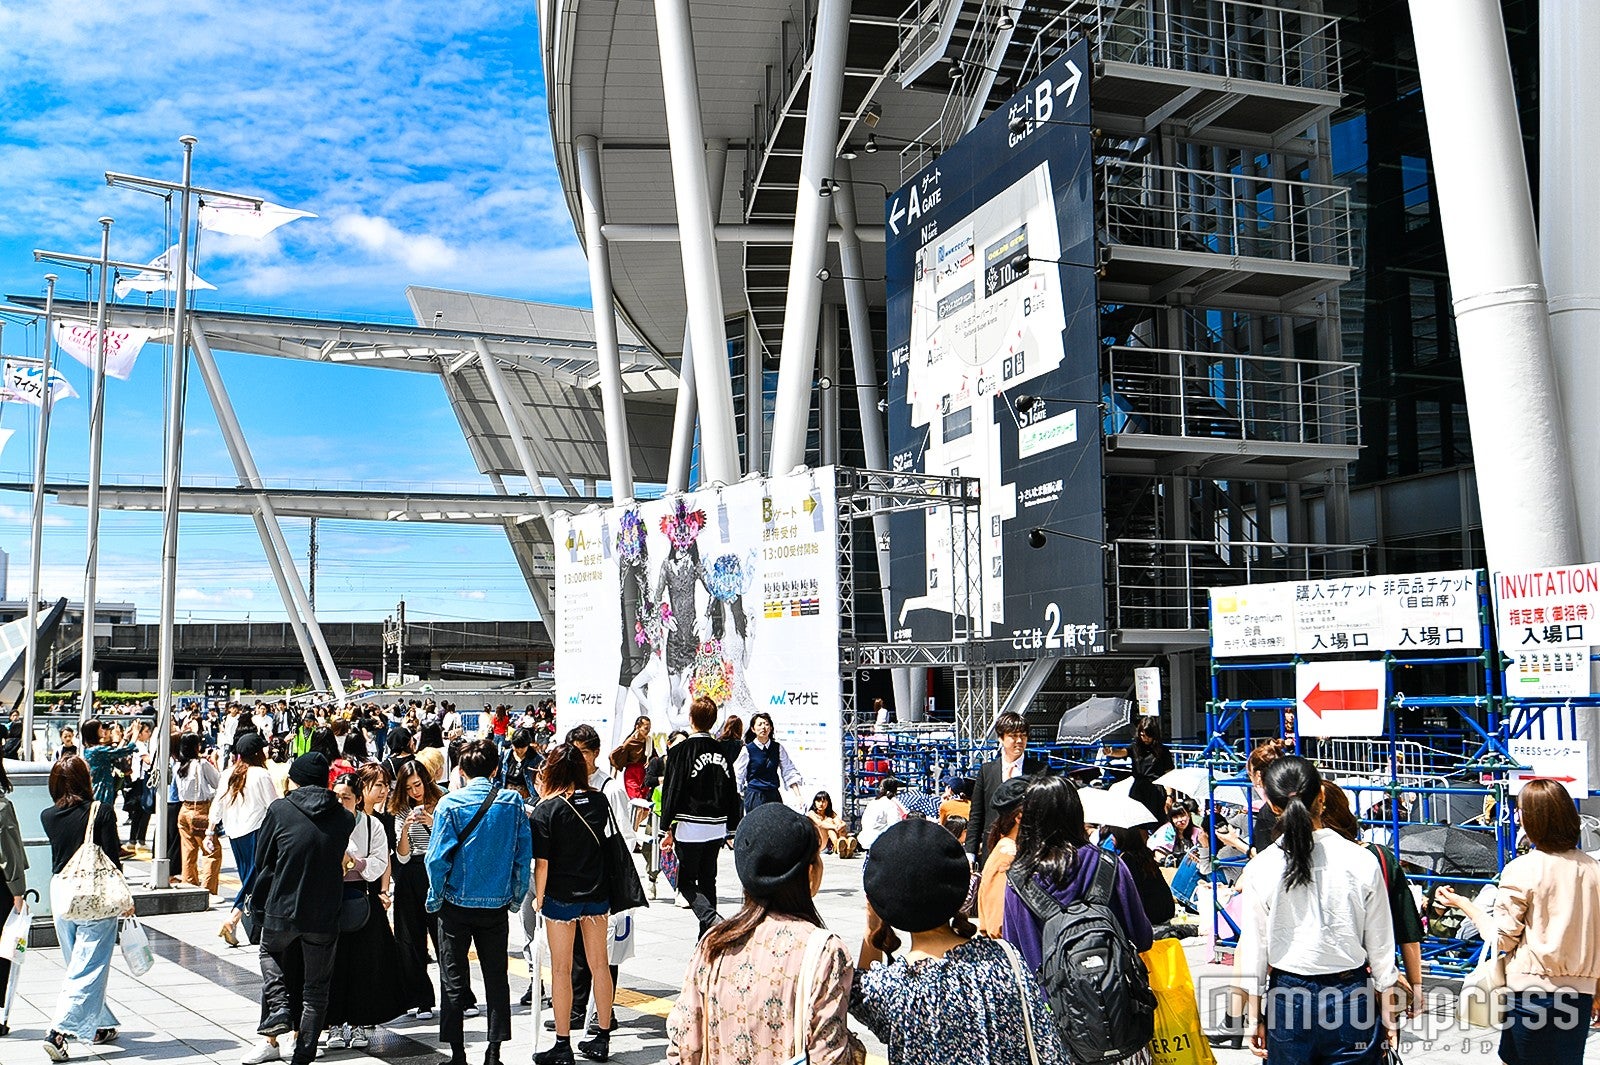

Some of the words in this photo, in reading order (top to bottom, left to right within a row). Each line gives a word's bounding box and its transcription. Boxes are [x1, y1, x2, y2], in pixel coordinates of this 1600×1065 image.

[1035, 79, 1054, 129] B
[921, 167, 941, 194] ゲート
[907, 184, 921, 226] A
[921, 188, 941, 214] GATE
[921, 225, 928, 245] N
[1023, 297, 1032, 318] B
[926, 350, 934, 368] A
[1004, 361, 1012, 379] P
[977, 378, 985, 396] C
[1032, 409, 1047, 424] GATE
[762, 525, 798, 542] 招待受付
[763, 542, 820, 561] 13:00受付開始
[1296, 580, 1377, 602] 購入チケット
[1383, 575, 1473, 596] 非売品チケット
[1501, 567, 1598, 600] INVITATION
[1012, 602, 1099, 650] ここは2階です
[1223, 616, 1242, 626] TGC
[1244, 613, 1283, 625] Premium
[1244, 625, 1262, 637] 会員
[1398, 626, 1464, 646] 入場口
[1521, 624, 1583, 645] 入場口
[1311, 632, 1369, 650] 入場口
[580, 693, 602, 705] マイナビ
[787, 692, 819, 705] マイナビ
[1173, 1033, 1191, 1052] 21
